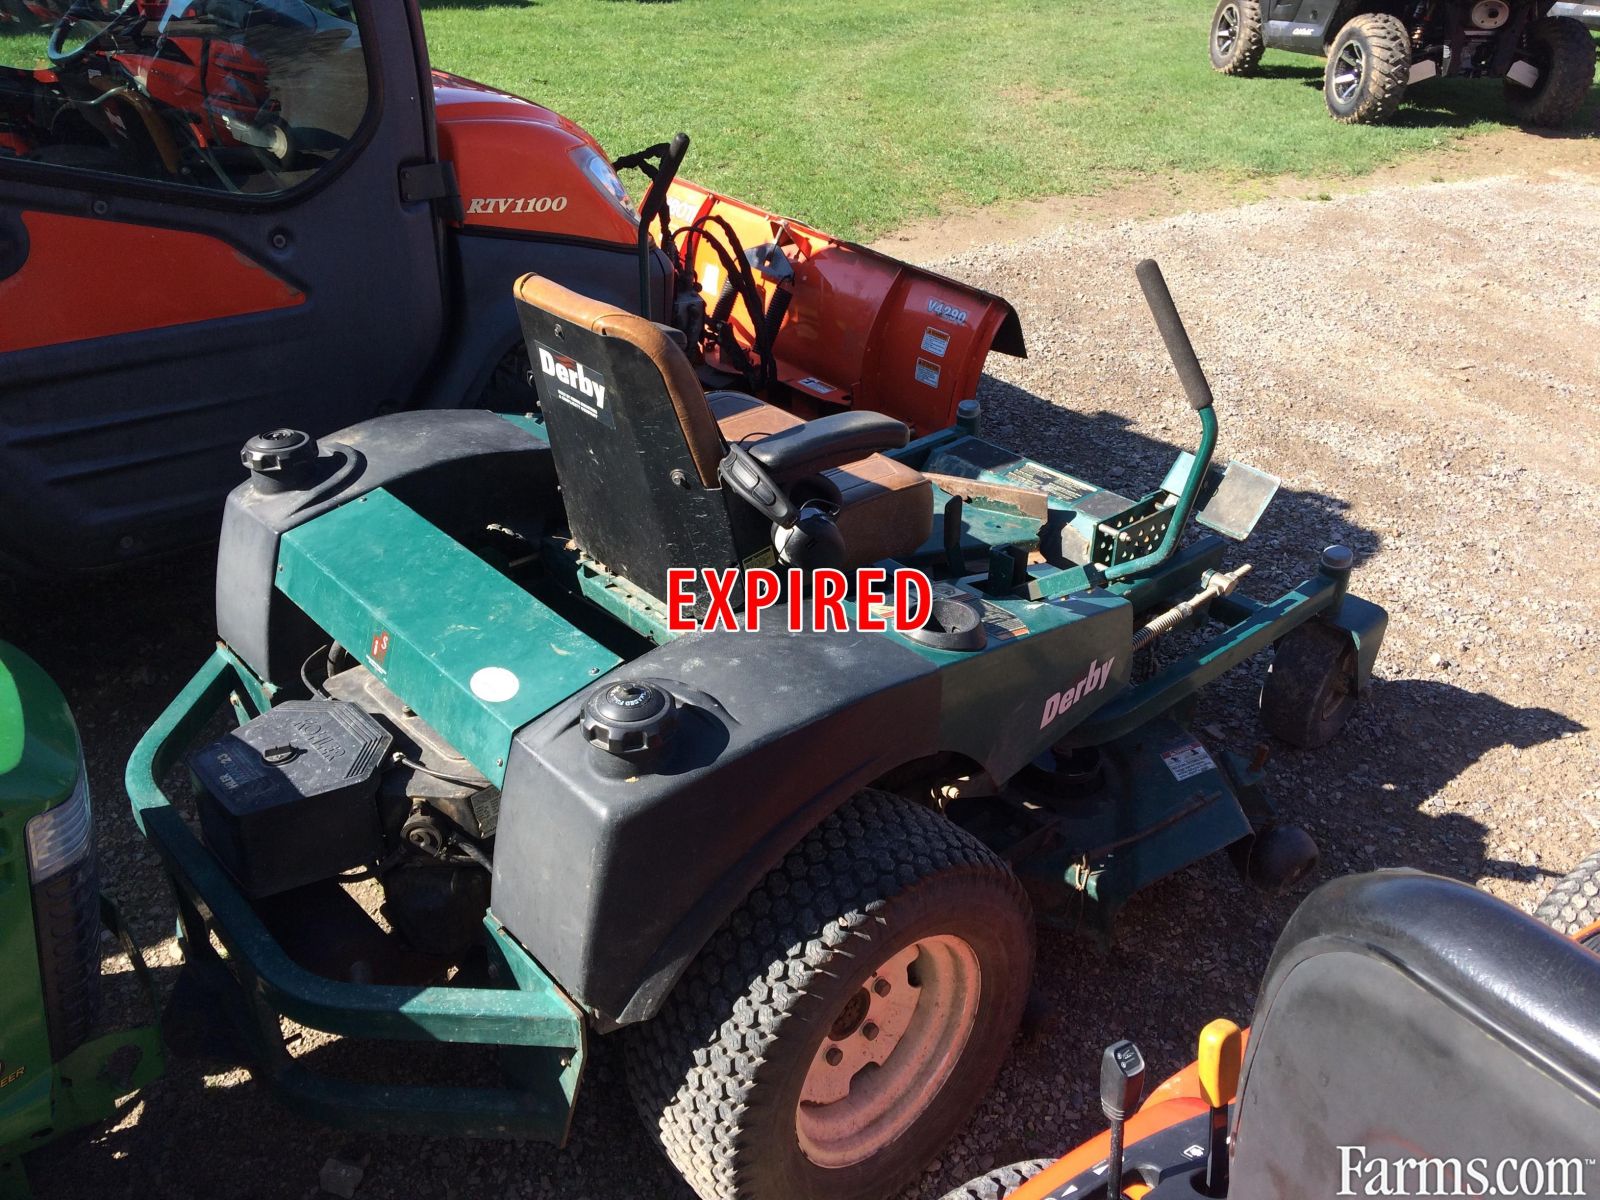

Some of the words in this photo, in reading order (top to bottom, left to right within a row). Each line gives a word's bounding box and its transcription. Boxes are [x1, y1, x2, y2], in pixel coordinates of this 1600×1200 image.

[466, 196, 568, 214] RTV1100
[927, 299, 968, 323] V4290
[538, 347, 606, 410] Derby
[1039, 656, 1116, 731] Derby
